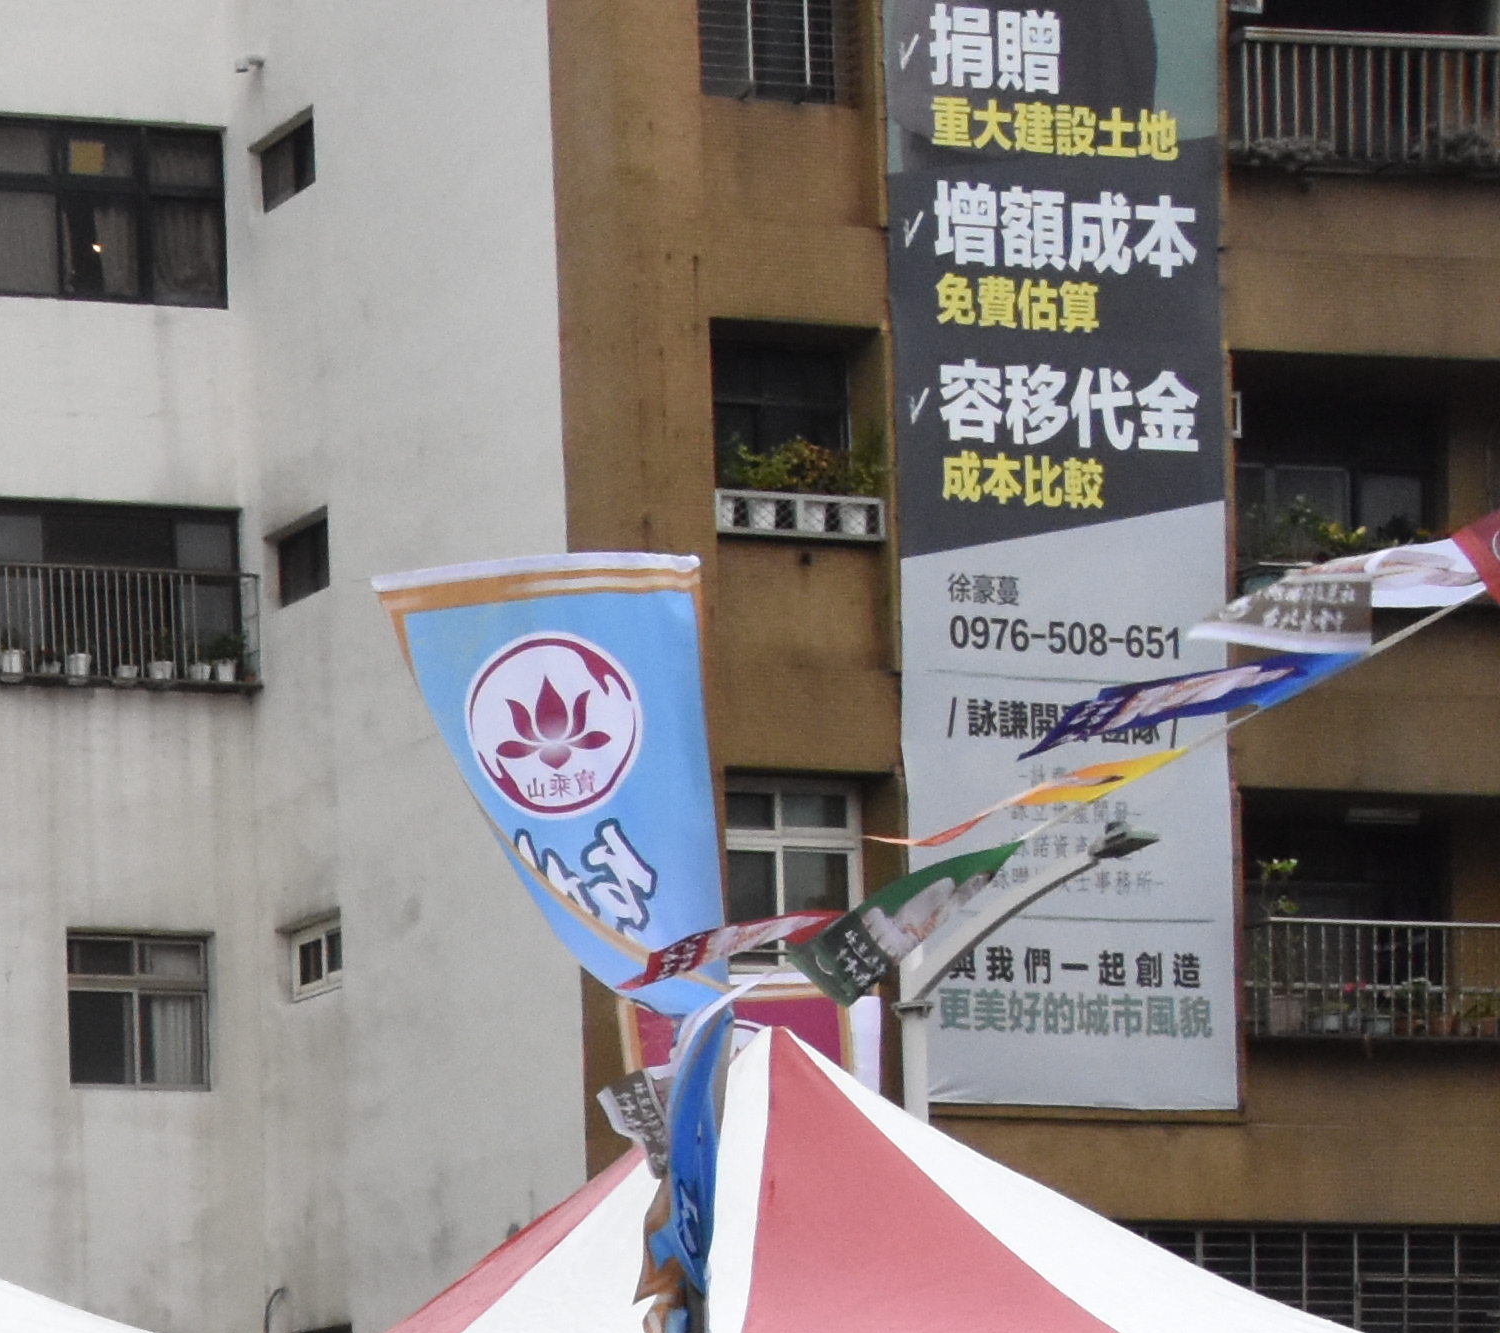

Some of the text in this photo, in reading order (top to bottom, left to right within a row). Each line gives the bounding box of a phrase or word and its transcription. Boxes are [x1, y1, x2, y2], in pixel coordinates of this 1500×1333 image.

[929, 3, 1062, 95] 捐贈
[931, 96, 1179, 162] 重大建設土地
[933, 180, 1198, 278] 增額成本
[935, 273, 1100, 333] 免費估算
[939, 359, 1200, 453] 容移代金
[942, 450, 1104, 510] 成本比較
[948, 613, 1182, 660] 0976-508-651
[939, 987, 1213, 1038] 更美好的城市風貌
